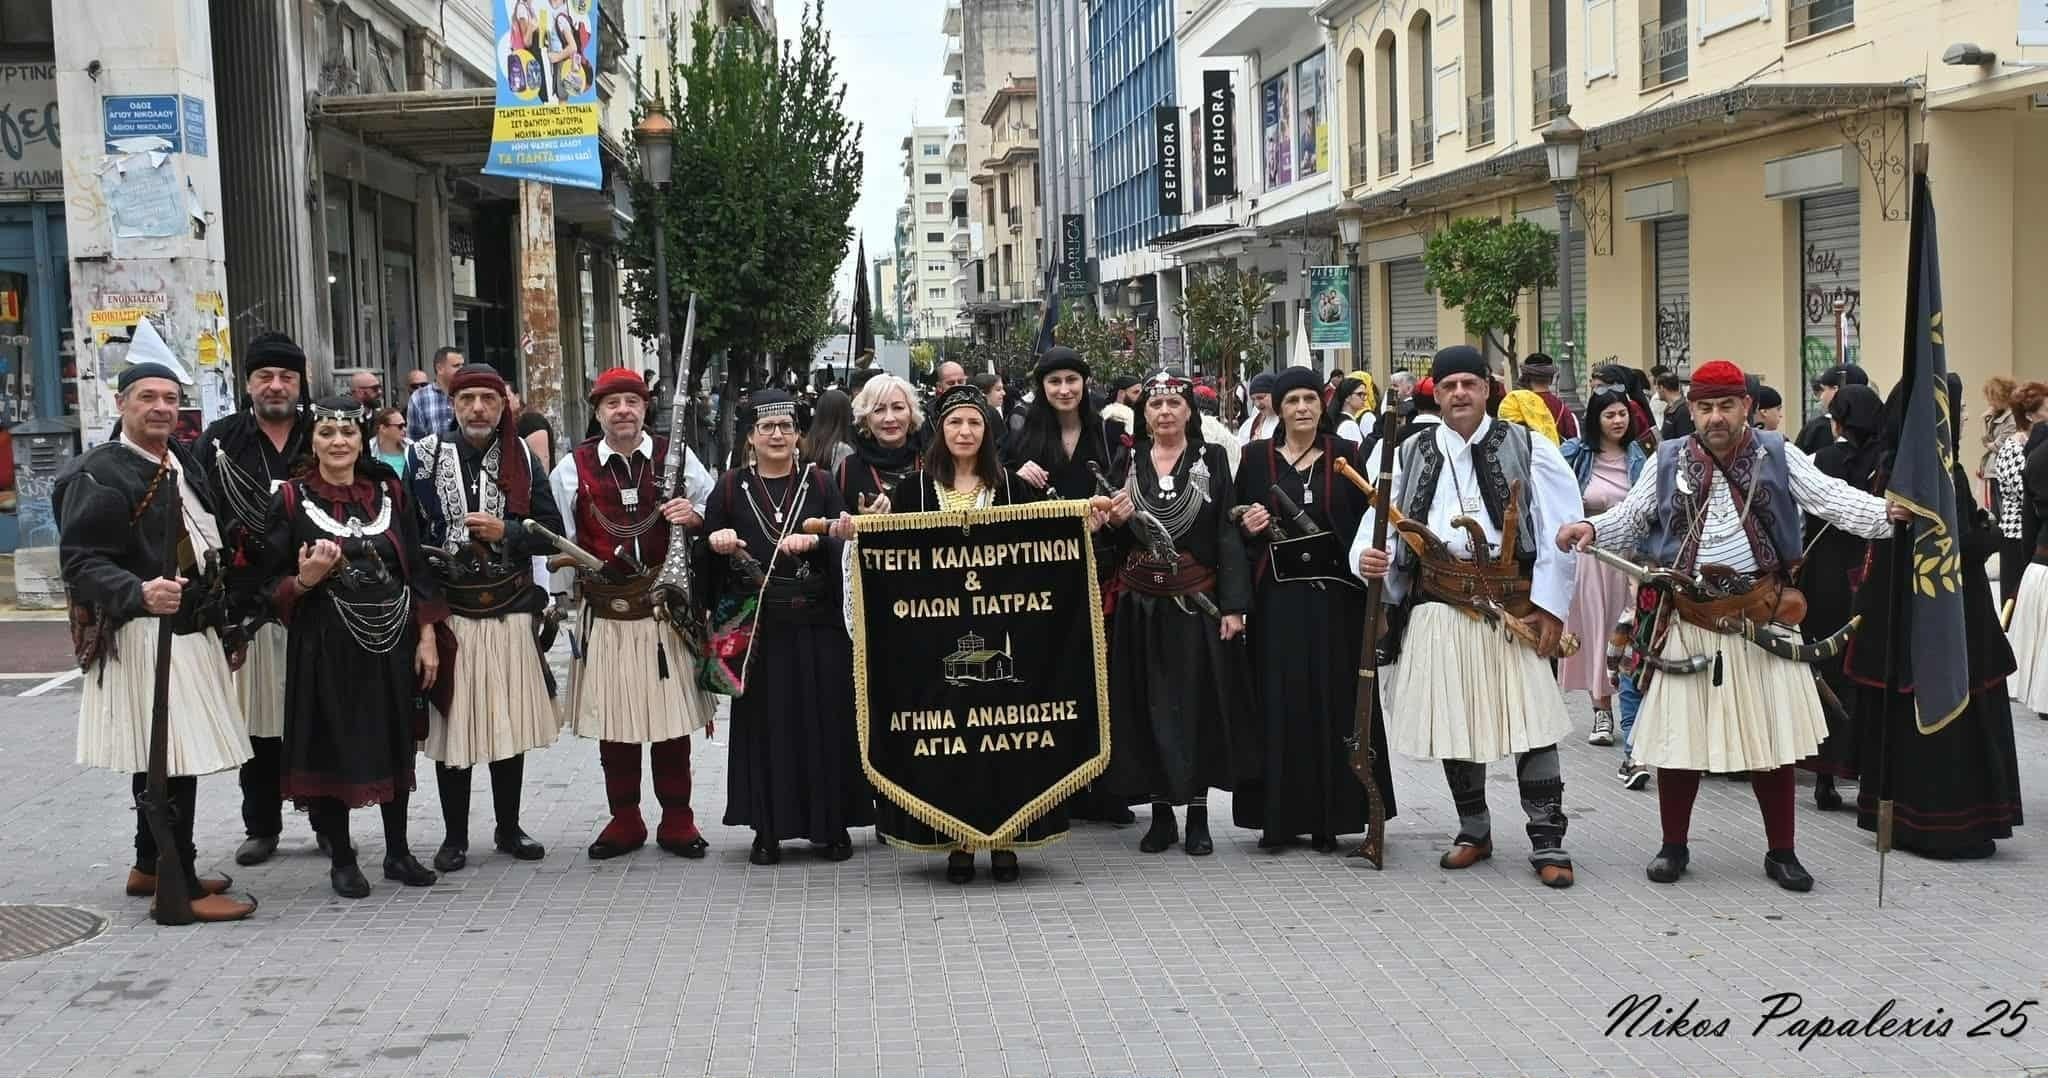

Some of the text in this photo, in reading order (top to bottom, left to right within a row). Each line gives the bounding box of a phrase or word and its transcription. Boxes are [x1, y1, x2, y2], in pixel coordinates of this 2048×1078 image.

[129, 102, 152, 110] ΟΔΟΣ
[134, 111, 174, 119] ΝΙΚΟΛΑΟΥ
[498, 104, 593, 118] ΤΣΑΝΤΕΣ ΚΑΣΕΤΙΝΕΣ ΤΕΤΡΑΔΙΑ
[1211, 88, 1226, 177] SEPHORA
[1163, 122, 1177, 199] SEPHORA
[108, 294, 164, 304] ΕΝΟΙΚΙΑΖΕΤΑΙ
[862, 538, 1080, 571] ΣΤΕΓΗ ΚΑΛΑΒΡΥΤΙΝΩΝ
[964, 570, 982, 591] &
[893, 591, 1053, 618] ΦΙΛΩΝ ΠΑΤΡΑΣ
[890, 700, 1078, 732] ΑΓΗΜΑ ΑΝΑΒΙΩΣΗΣ
[913, 730, 1055, 757] ΑΓΙΑ ΛΑΥΡΑ
